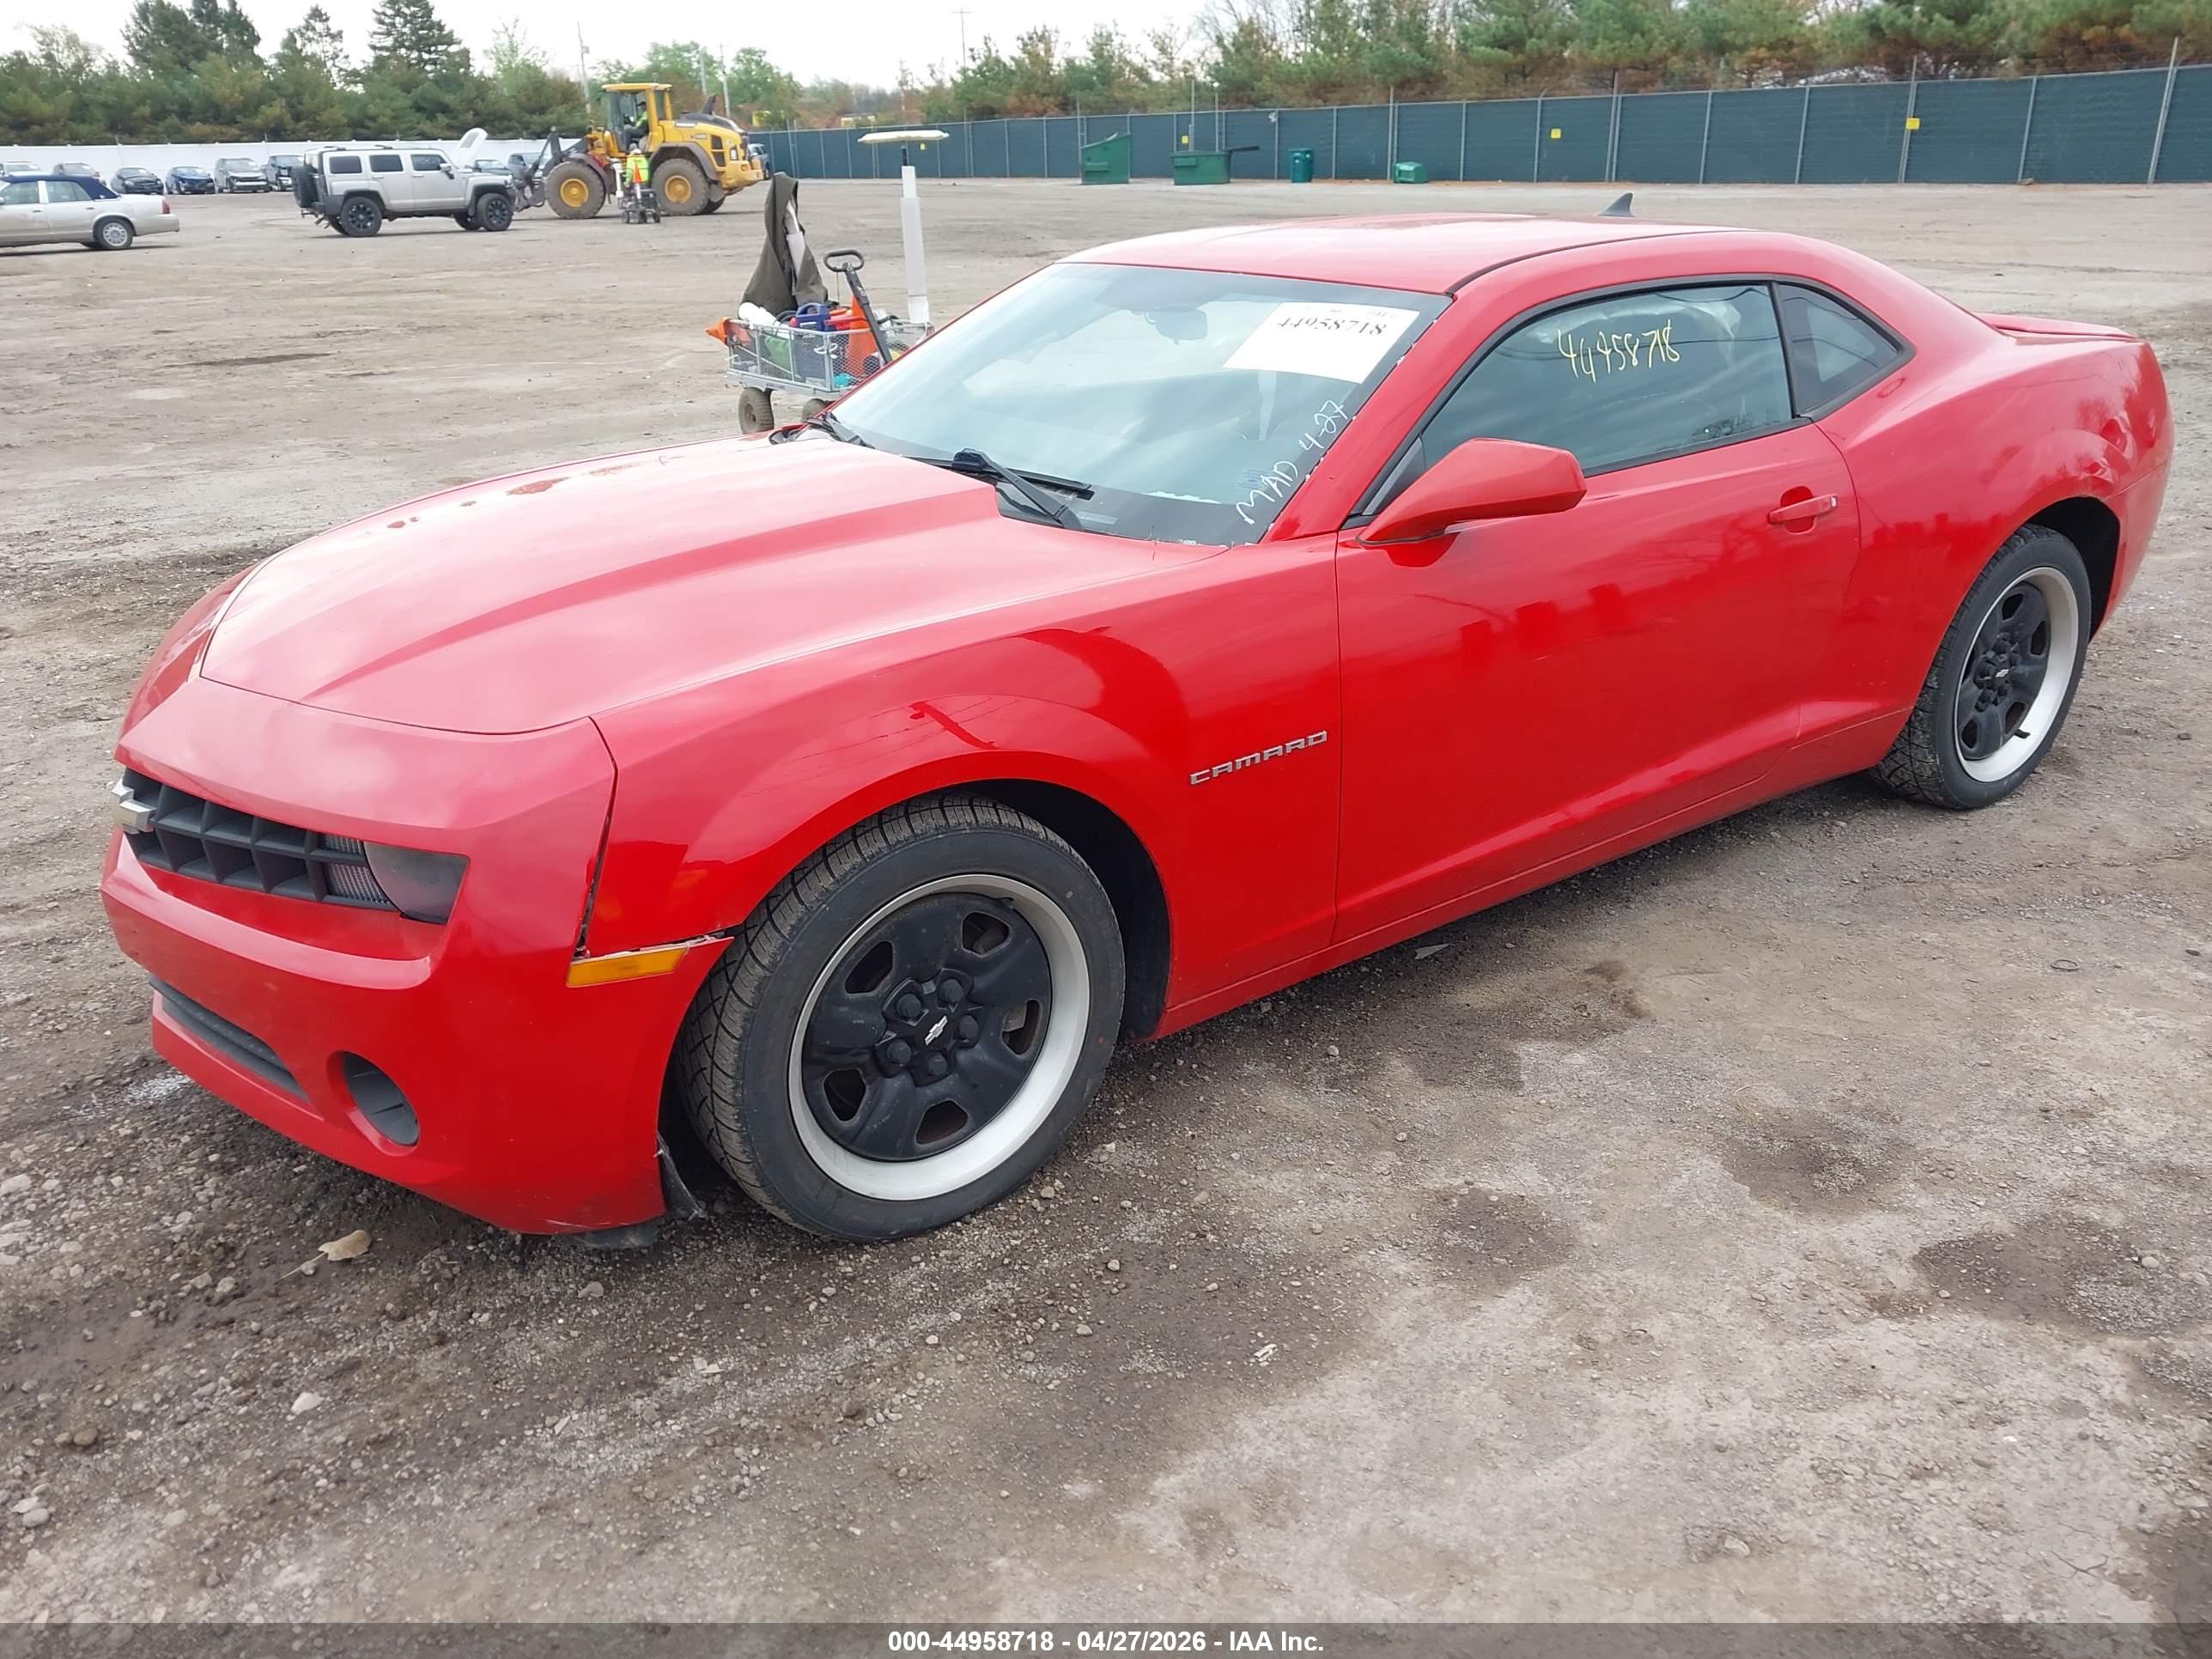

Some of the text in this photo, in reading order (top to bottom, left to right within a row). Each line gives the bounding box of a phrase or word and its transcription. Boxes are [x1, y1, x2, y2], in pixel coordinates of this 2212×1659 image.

[1236, 460, 1298, 525] MAD
[1298, 399, 1348, 451] 4-27
[1189, 730, 1328, 785] CAMARO
